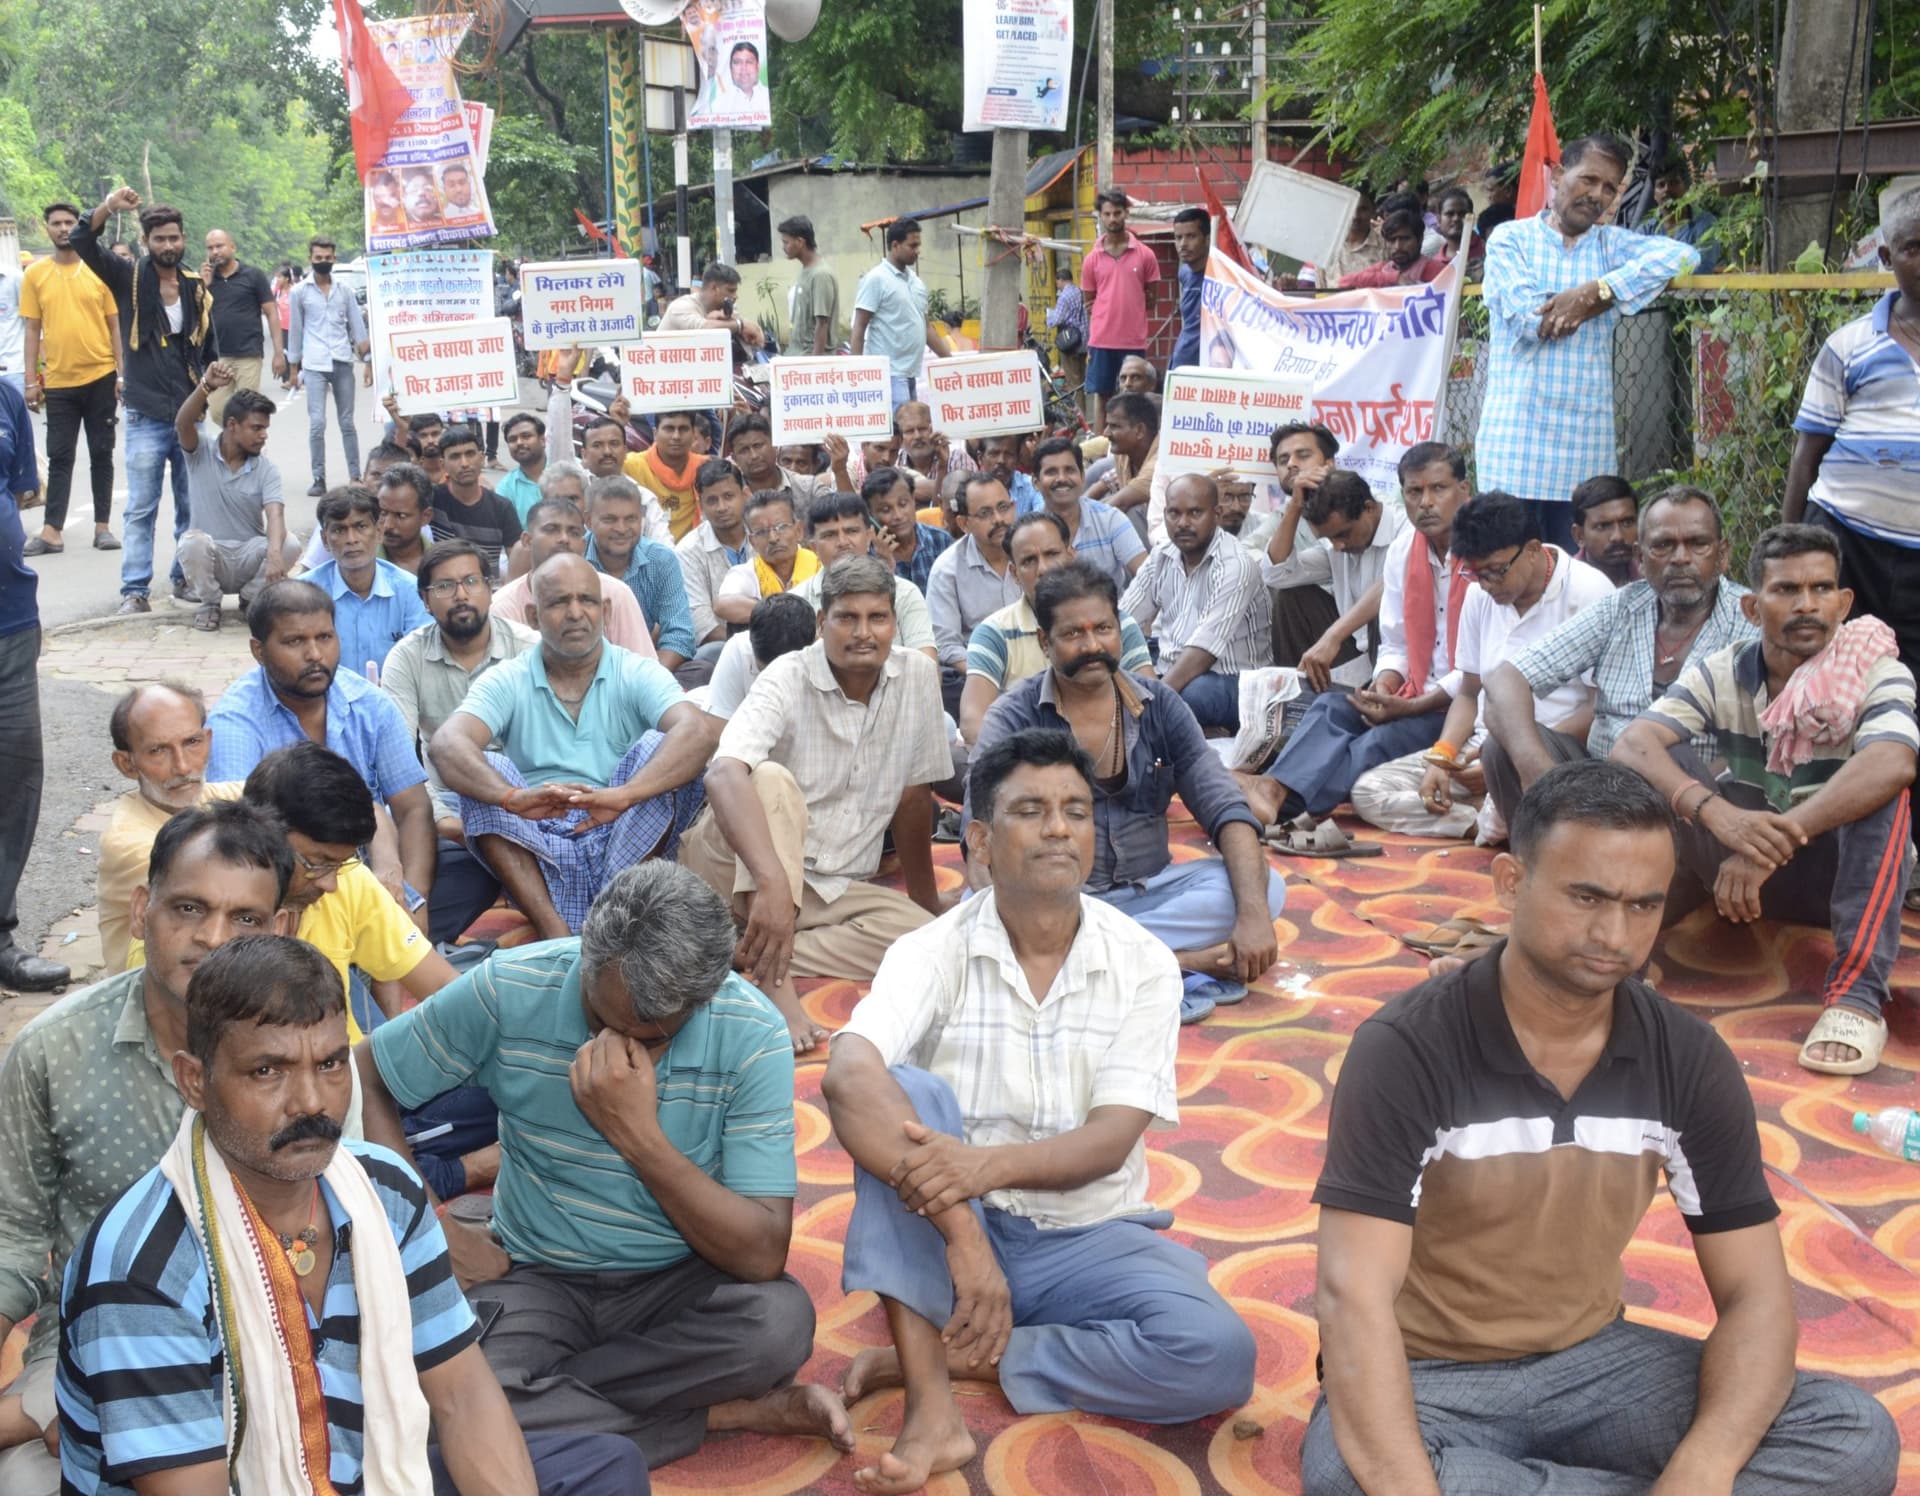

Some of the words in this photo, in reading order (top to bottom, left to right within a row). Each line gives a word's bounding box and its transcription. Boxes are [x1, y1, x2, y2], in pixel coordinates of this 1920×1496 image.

[996, 15, 1018, 25] LEARN
[996, 30, 1009, 40] GET
[1010, 30, 1038, 41] PLACED
[535, 275, 593, 292] मिलकर
[597, 271, 625, 289] लेंगे
[549, 299, 576, 314] नगर
[579, 295, 614, 313] निगम
[531, 319, 542, 335] के
[545, 317, 586, 339] बुल्डोजर
[588, 316, 597, 332] से
[396, 339, 428, 362] पहले
[432, 339, 474, 359] बसाया
[476, 336, 504, 354] जाए
[627, 344, 656, 365] पहले
[659, 348, 696, 364] बसाया
[699, 346, 724, 362] जाए
[405, 375, 431, 396] फिर
[433, 373, 473, 396] उजाड़ा
[476, 371, 504, 389] जाए
[632, 377, 655, 396] फिर
[658, 379, 694, 399] उजाड़ा
[696, 378, 722, 393] जाए
[781, 371, 812, 391] पुलिस
[814, 367, 843, 385] लाईन
[847, 368, 882, 387] फुटपाथ
[934, 370, 963, 393] पहले
[966, 370, 1003, 389] बसाया
[1007, 367, 1032, 384] जाए
[783, 392, 824, 412] दुकानदार
[826, 388, 839, 404] को
[842, 389, 883, 408] पशुपालन
[1173, 385, 1198, 402] जाए
[1200, 387, 1236, 405] बसाया
[1252, 391, 1303, 410] अस्पताल
[941, 403, 964, 423] फिर
[968, 402, 1003, 422] उजाड़ा
[1005, 399, 1032, 416] जाए
[783, 416, 822, 432] अस्पताल
[836, 414, 864, 429] बसाया
[867, 413, 886, 426] जाए
[1172, 411, 1223, 433] पशुपालन
[1227, 418, 1243, 438] को
[1311, 400, 1356, 444] रना
[1168, 437, 1213, 458] फुटपाथ
[1216, 443, 1253, 465] लाईन
